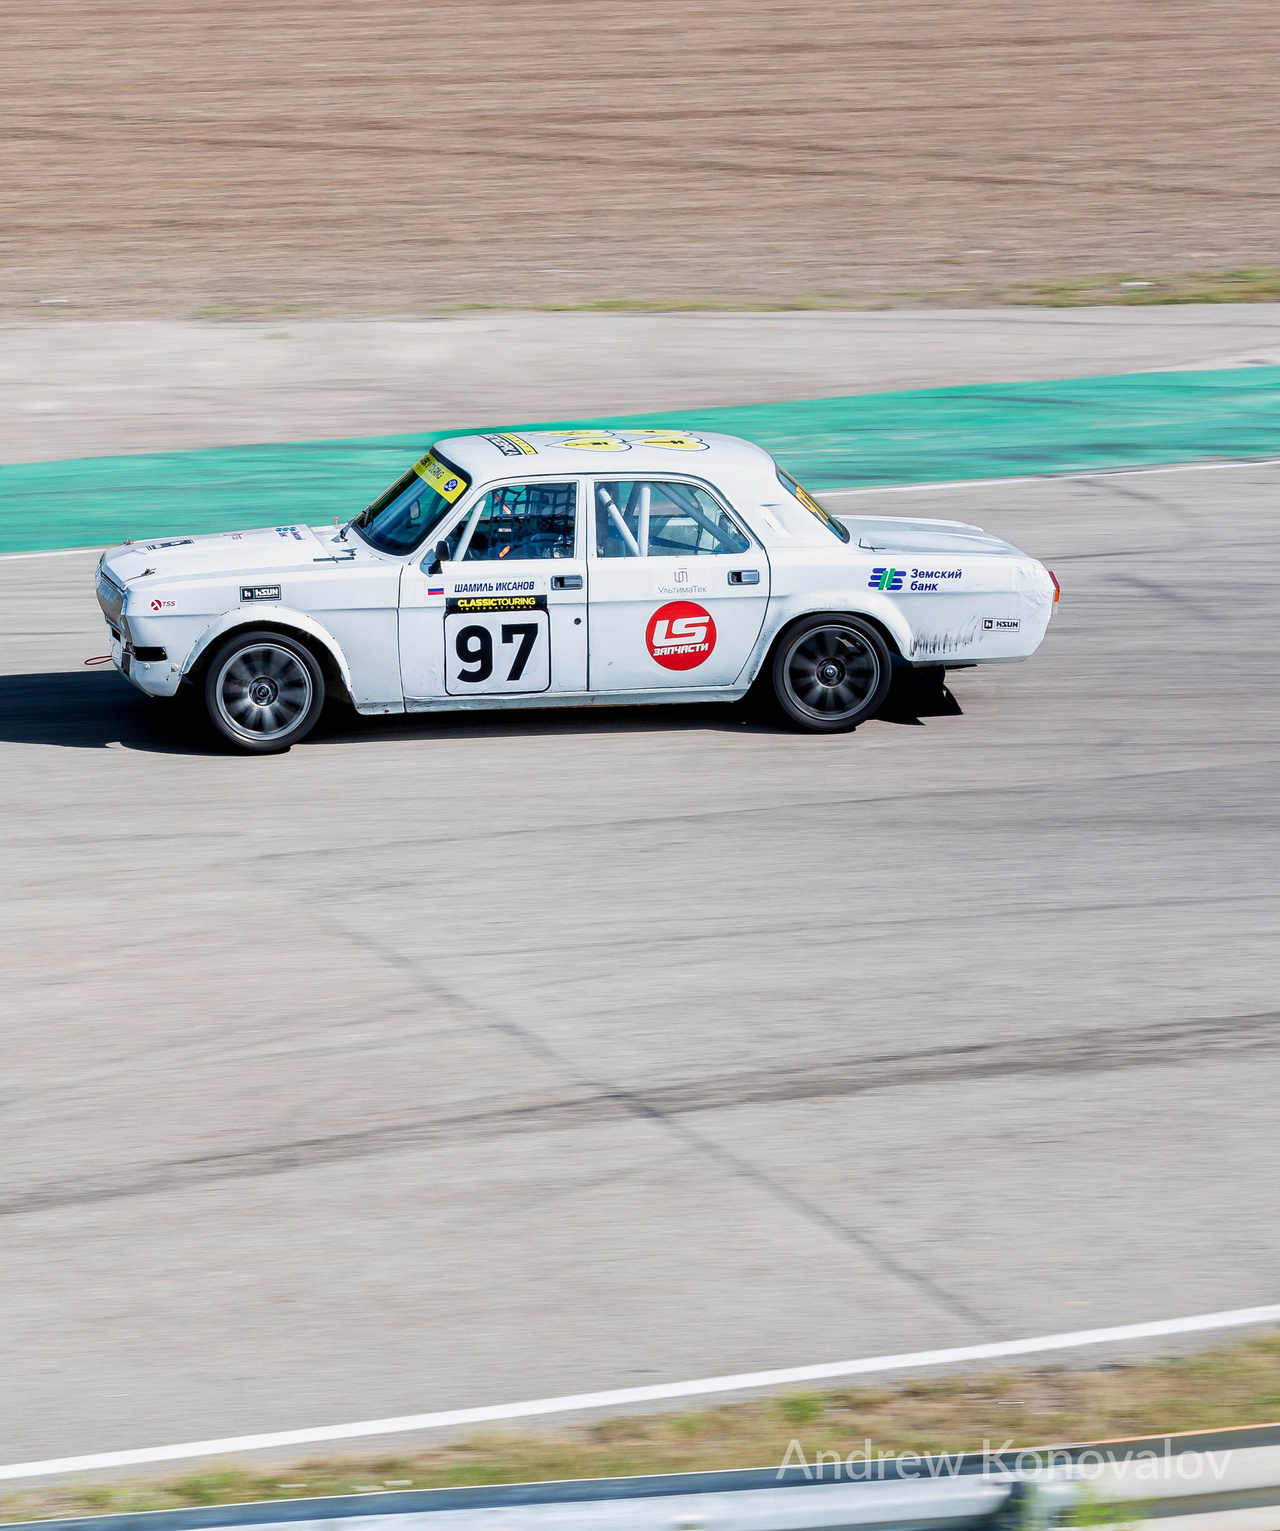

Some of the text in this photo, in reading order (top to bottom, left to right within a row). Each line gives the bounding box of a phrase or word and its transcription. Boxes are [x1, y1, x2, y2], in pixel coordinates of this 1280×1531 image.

[910, 568, 962, 579] Земский
[454, 581, 535, 593] ШАМИЛЬ ИКСАНОВ
[910, 580, 938, 591] банк
[652, 615, 710, 647] LS
[455, 623, 539, 683] 97
[652, 642, 710, 656] ЗАПЧАСТИ
